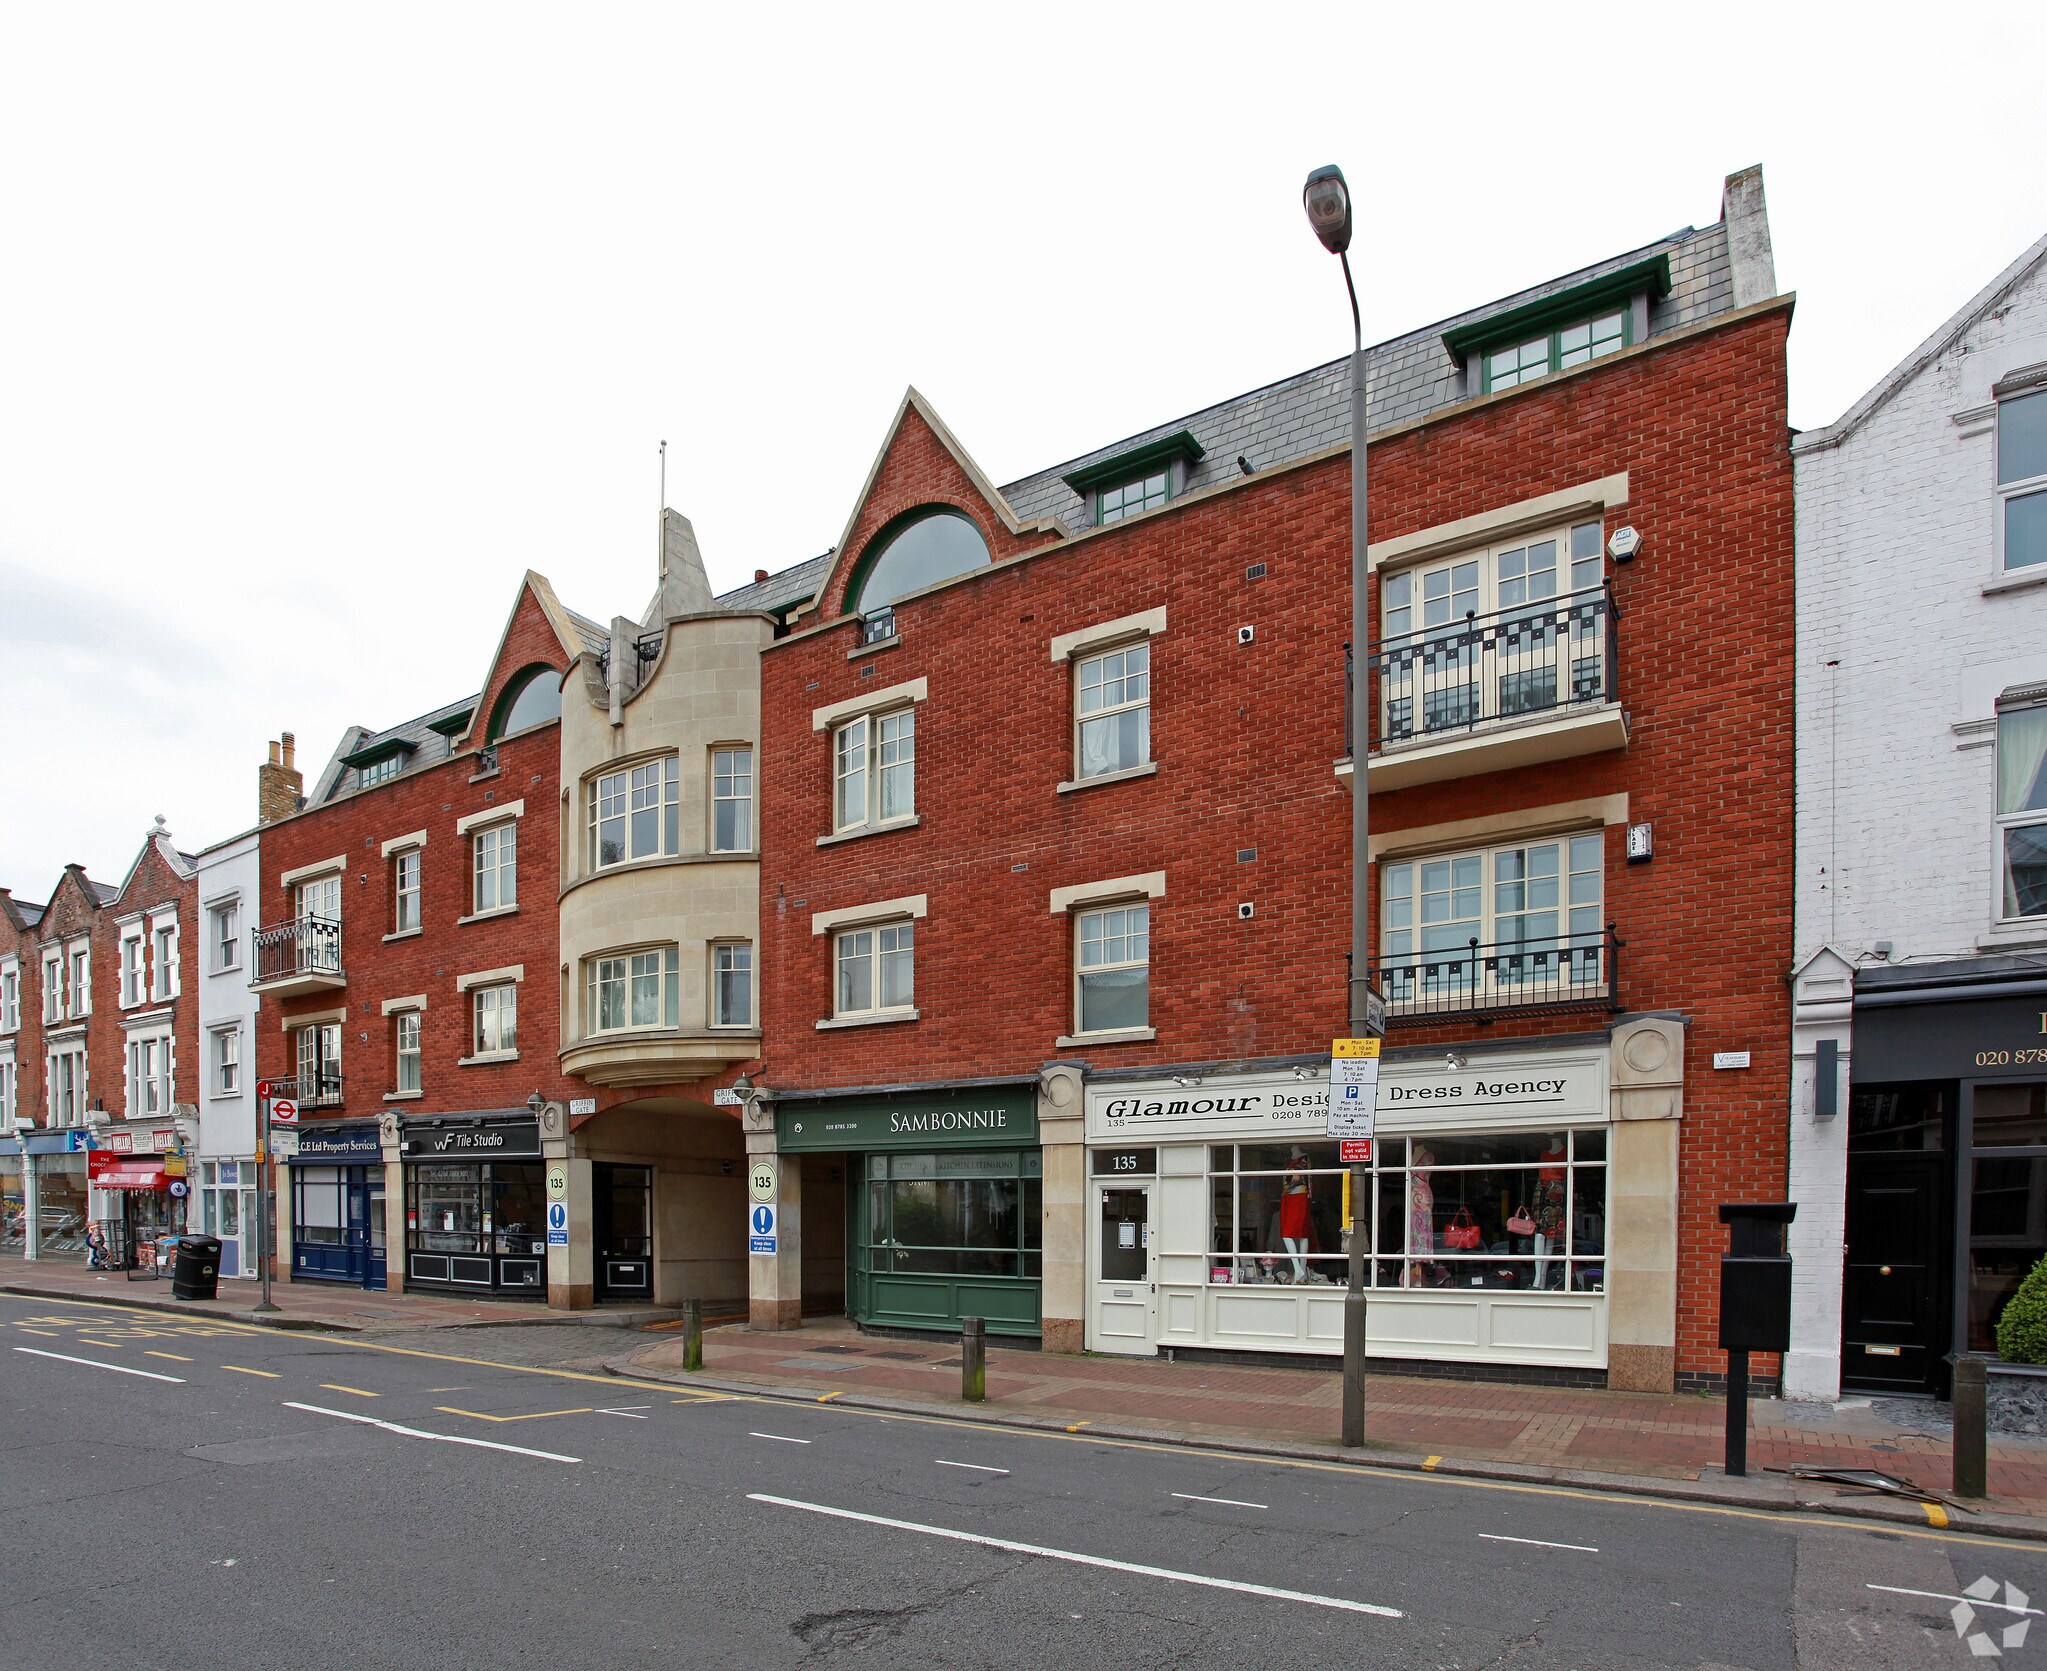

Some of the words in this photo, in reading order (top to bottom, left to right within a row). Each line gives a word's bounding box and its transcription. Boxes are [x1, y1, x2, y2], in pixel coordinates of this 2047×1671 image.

[1616, 530, 1631, 539] ADT
[1975, 1050, 2009, 1066] 020
[262, 1083, 269, 1095] J
[1348, 1087, 1357, 1098] P
[1390, 1083, 1463, 1101] Dress
[1473, 1079, 1567, 1097] Agency
[571, 1100, 593, 1108] GRIFFIN
[576, 1106, 590, 1114] GATE
[1105, 1096, 1261, 1118] Glamour
[890, 1109, 1007, 1133] SAMBONNIE
[1271, 1110, 1302, 1120] 0208
[1107, 1119, 1125, 1127] 135
[456, 1134, 472, 1148] Tile
[473, 1132, 503, 1147] Studio
[312, 1142, 322, 1152] Ltd
[323, 1141, 350, 1154] Property
[350, 1139, 377, 1151] Services
[938, 1162, 970, 1170] KITCHEN
[971, 1161, 1014, 1169] EXTENSIONS
[1113, 1155, 1137, 1170] 135
[550, 1179, 563, 1189] 135
[755, 1176, 771, 1188] 135
